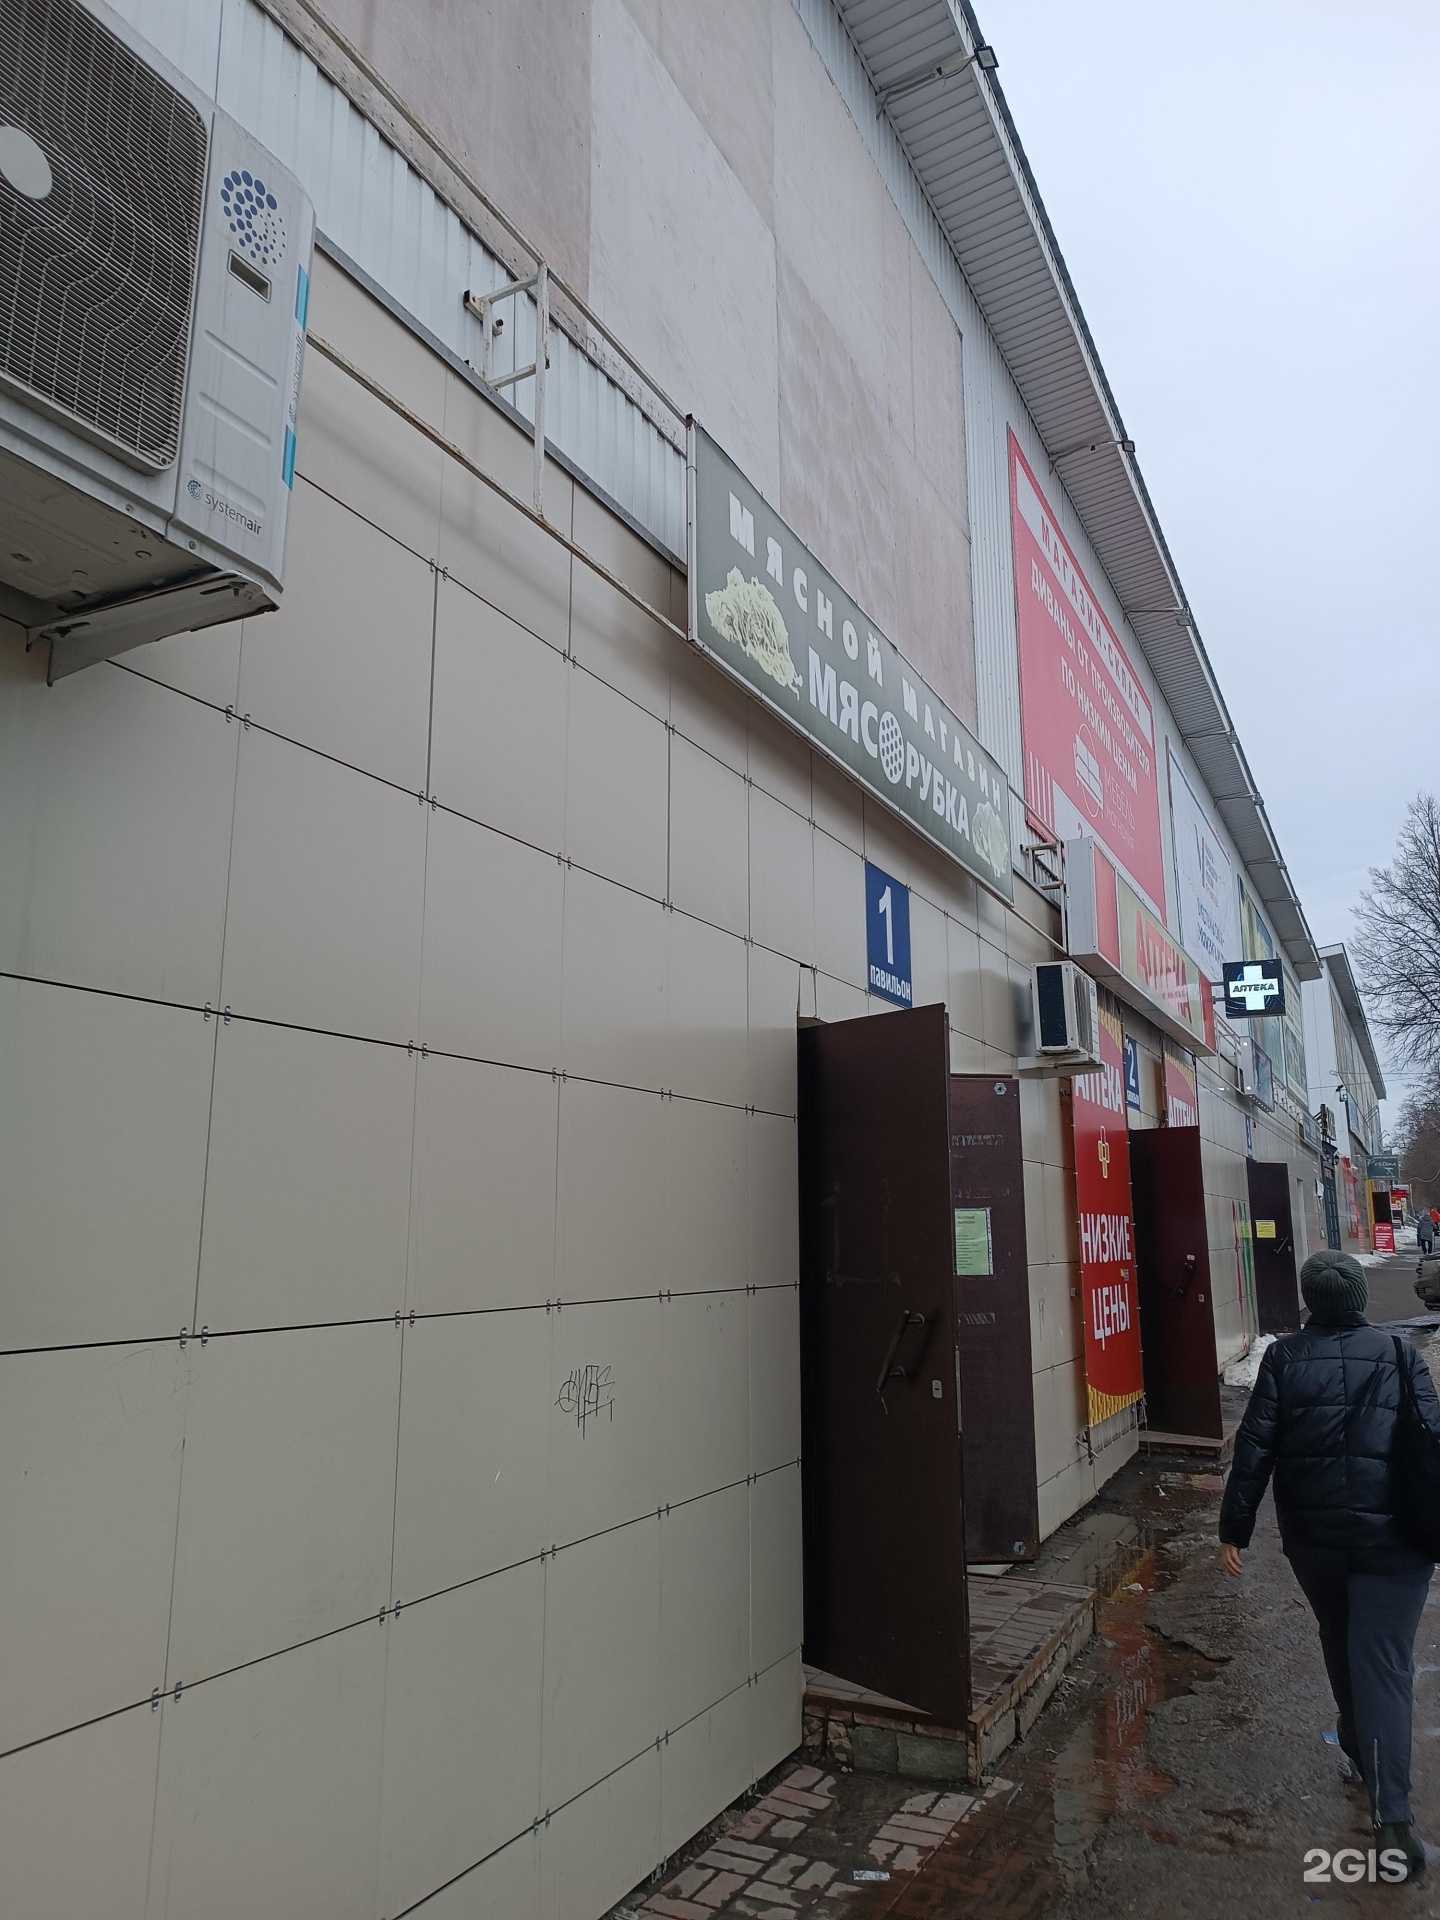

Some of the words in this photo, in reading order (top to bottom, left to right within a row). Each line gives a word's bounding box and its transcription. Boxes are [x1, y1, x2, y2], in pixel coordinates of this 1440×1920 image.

[204, 494, 262, 535] systemair
[1031, 559, 1077, 653] ДИВАНЫ
[1077, 637, 1089, 676] ОТ
[729, 491, 883, 688] МЯСНОЙ
[902, 676, 1001, 812] МАГАЗИН
[1061, 655, 1075, 697] ПО
[1077, 680, 1112, 753] НИЗКИМ
[808, 645, 970, 841] МЯСОРУБКА
[879, 885, 894, 965] 1
[870, 964, 911, 1001] павильон
[1232, 982, 1275, 993] АПТЕКА
[1127, 1041, 1136, 1088] 2
[1080, 1213, 1131, 1264] НИЗКИЕ
[1092, 1283, 1130, 1350] ЦЕНЫ
